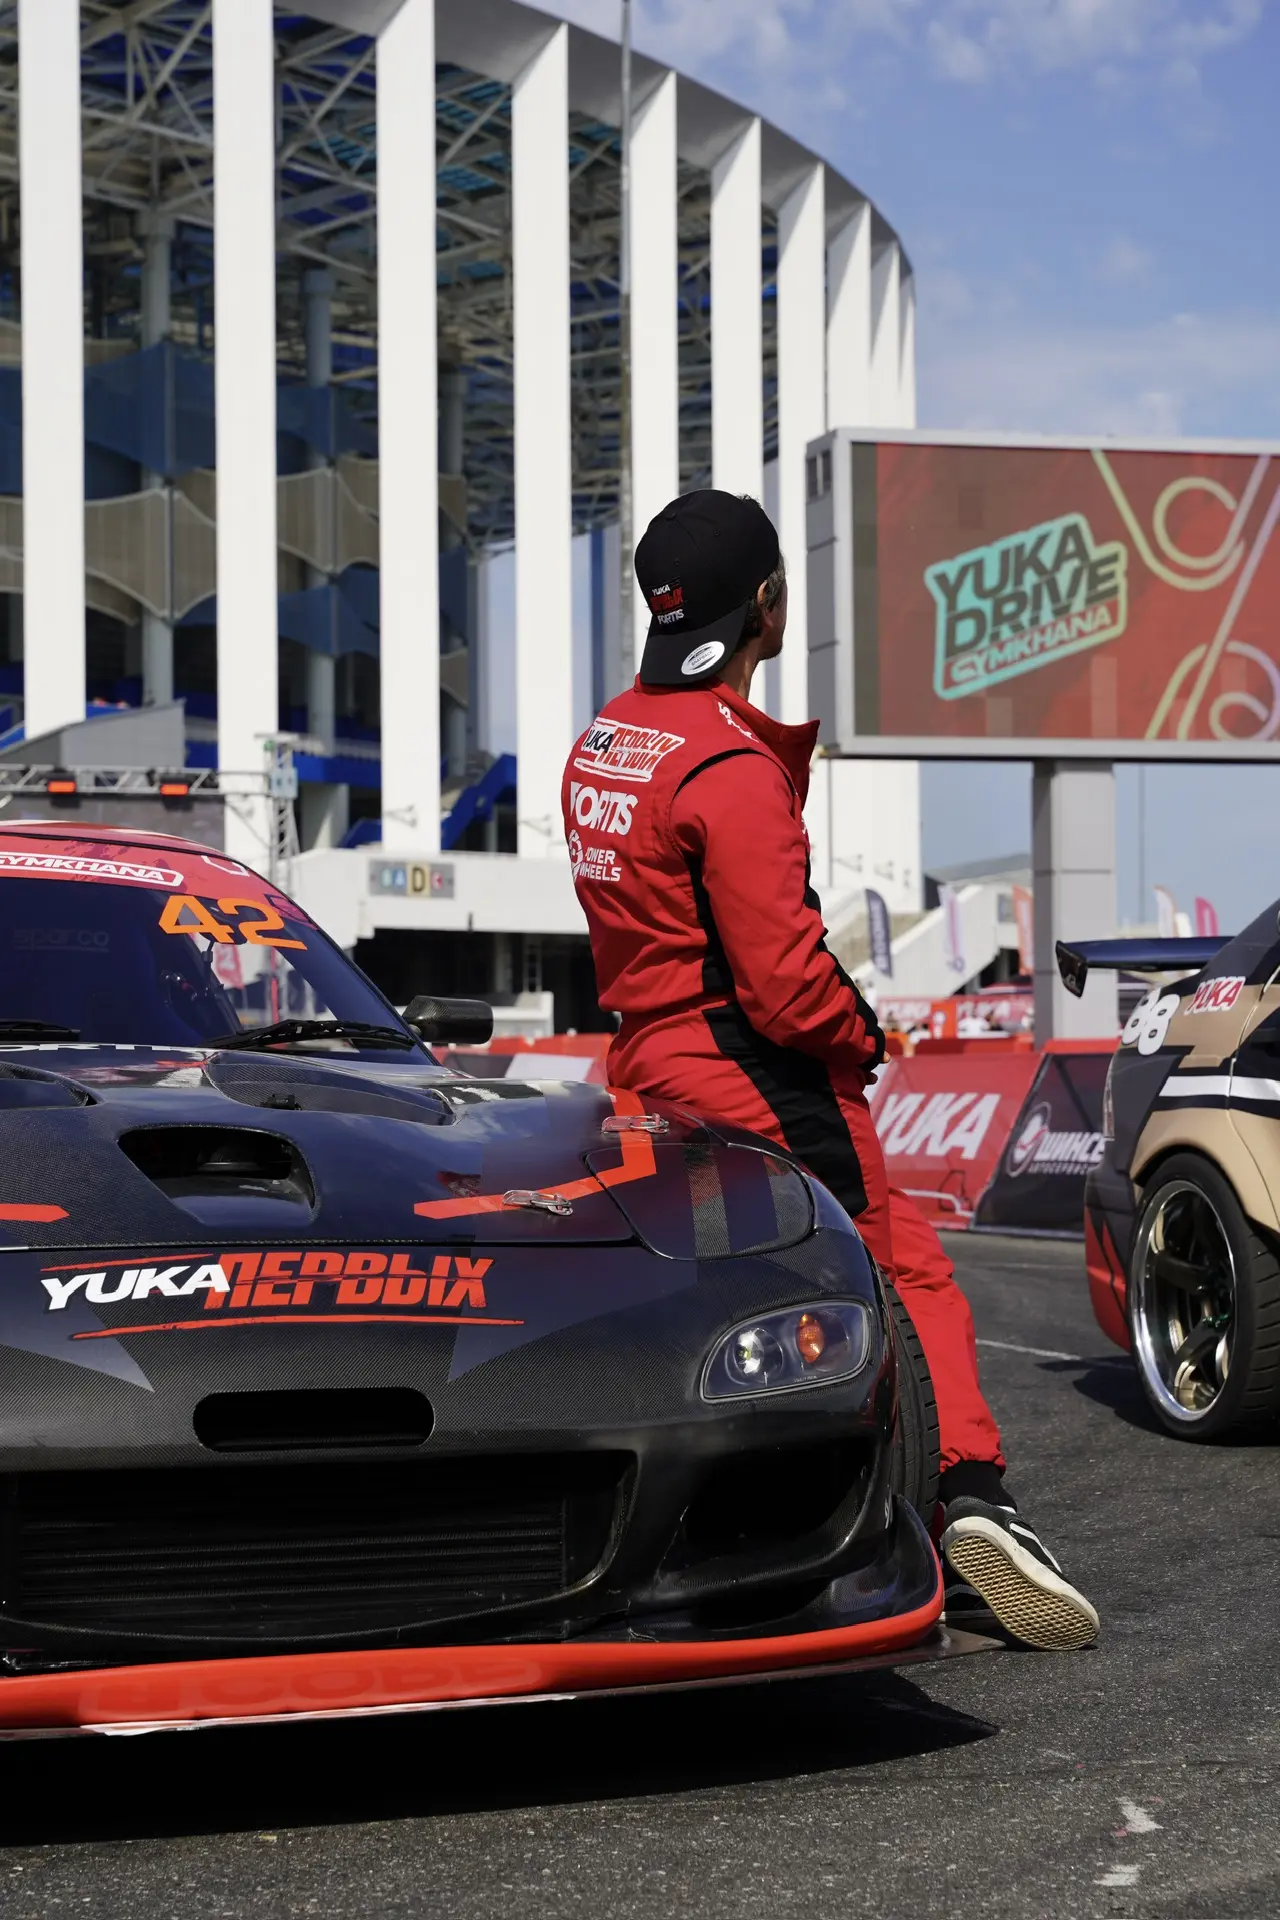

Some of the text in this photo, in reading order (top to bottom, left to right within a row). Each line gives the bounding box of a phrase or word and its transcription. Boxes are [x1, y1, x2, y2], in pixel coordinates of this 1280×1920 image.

[652, 584, 671, 597] YUKA
[933, 524, 1090, 612] YUKA
[657, 609, 685, 625] FORTIS
[945, 551, 1120, 660] DRIVE
[951, 605, 1112, 682] GYMKHANA
[412, 866, 425, 892] D
[579, 861, 622, 882] WHEELS
[159, 895, 308, 951] 42
[1122, 986, 1181, 1056] 88
[1187, 979, 1244, 1012] YUKA
[40, 1252, 495, 1310] YUKA ПЕРВЫХ
